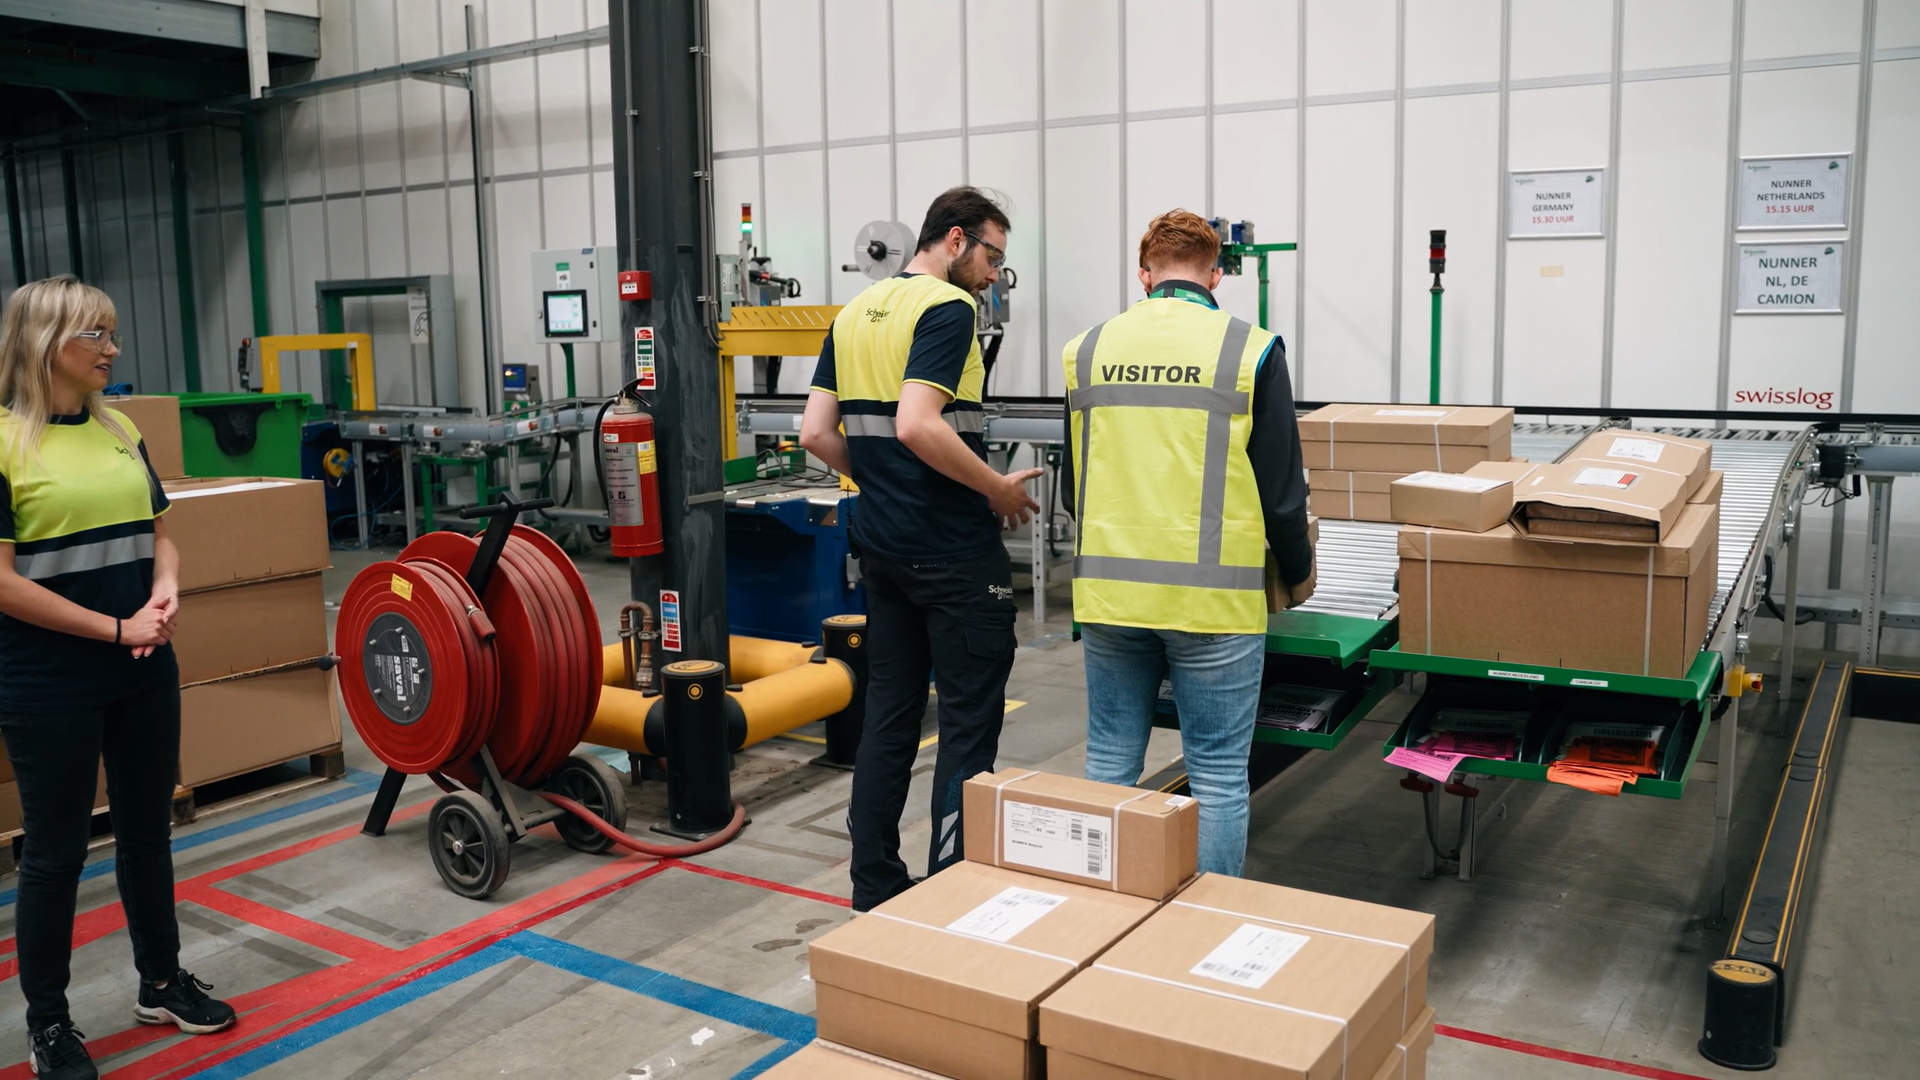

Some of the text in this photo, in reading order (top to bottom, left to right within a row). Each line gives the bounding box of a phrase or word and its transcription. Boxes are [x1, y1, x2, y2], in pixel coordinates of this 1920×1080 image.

[1771, 179, 1812, 188] NUNNER
[1535, 192, 1572, 200] NUNNER
[1757, 191, 1825, 201] NETHERLANDS
[1532, 204, 1574, 212] GERMANY
[1766, 204, 1815, 213] 15.15 UUR
[1532, 215, 1575, 224] 15.30 UUR
[1758, 257, 1818, 269] NUNNER
[1766, 275, 1809, 288] NL, DE
[1757, 293, 1815, 305] CAMION
[1101, 364, 1202, 384] VISITOR
[1734, 387, 1834, 411] swisslog
[393, 655, 407, 702] saval
